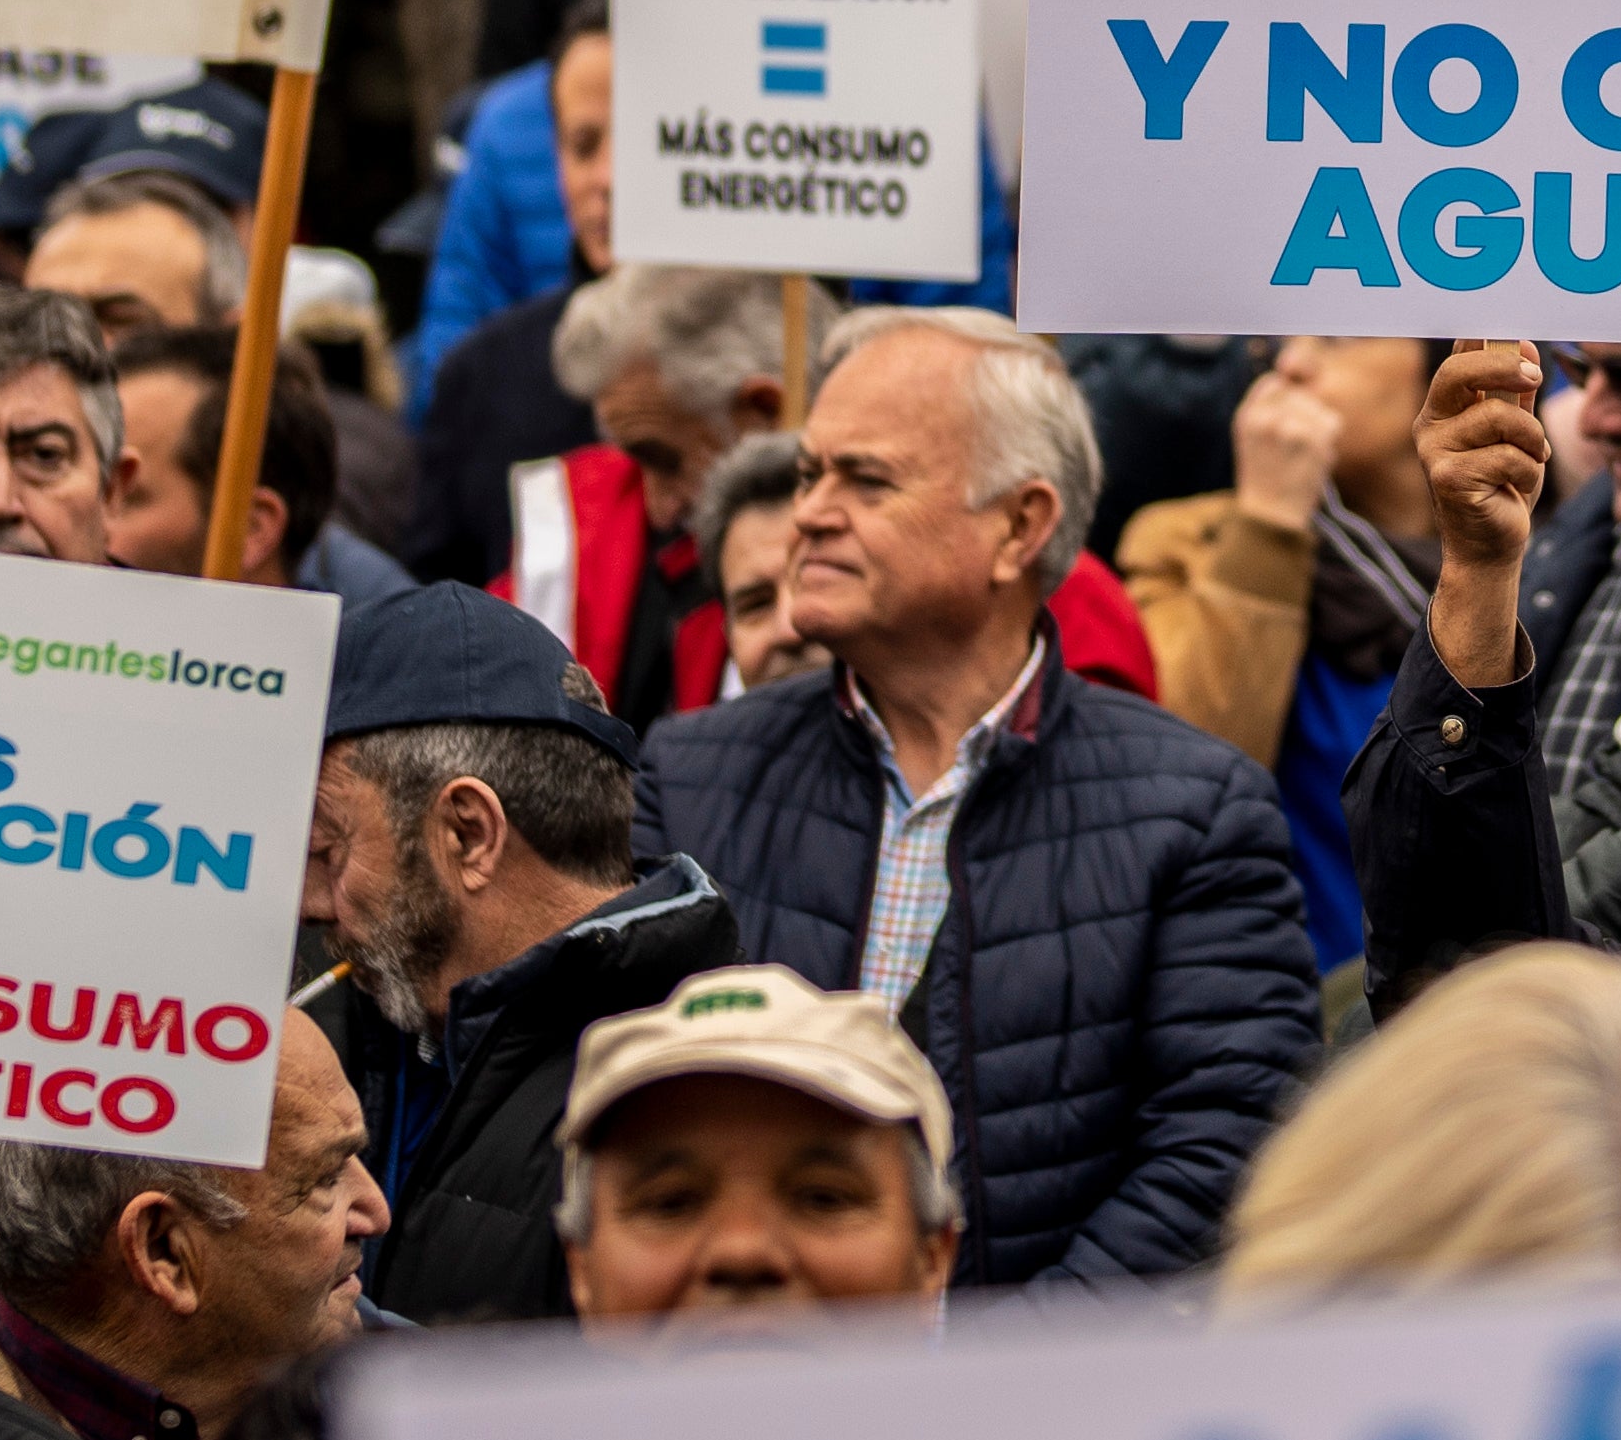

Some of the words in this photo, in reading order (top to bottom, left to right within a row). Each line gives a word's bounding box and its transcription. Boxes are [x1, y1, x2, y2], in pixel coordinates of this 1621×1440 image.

[1107, 18, 1230, 141] Y
[1266, 21, 1520, 147] NO
[659, 109, 733, 159] MÁS
[744, 124, 931, 168] CONSUMO
[680, 161, 908, 217] ENERGÉTICO
